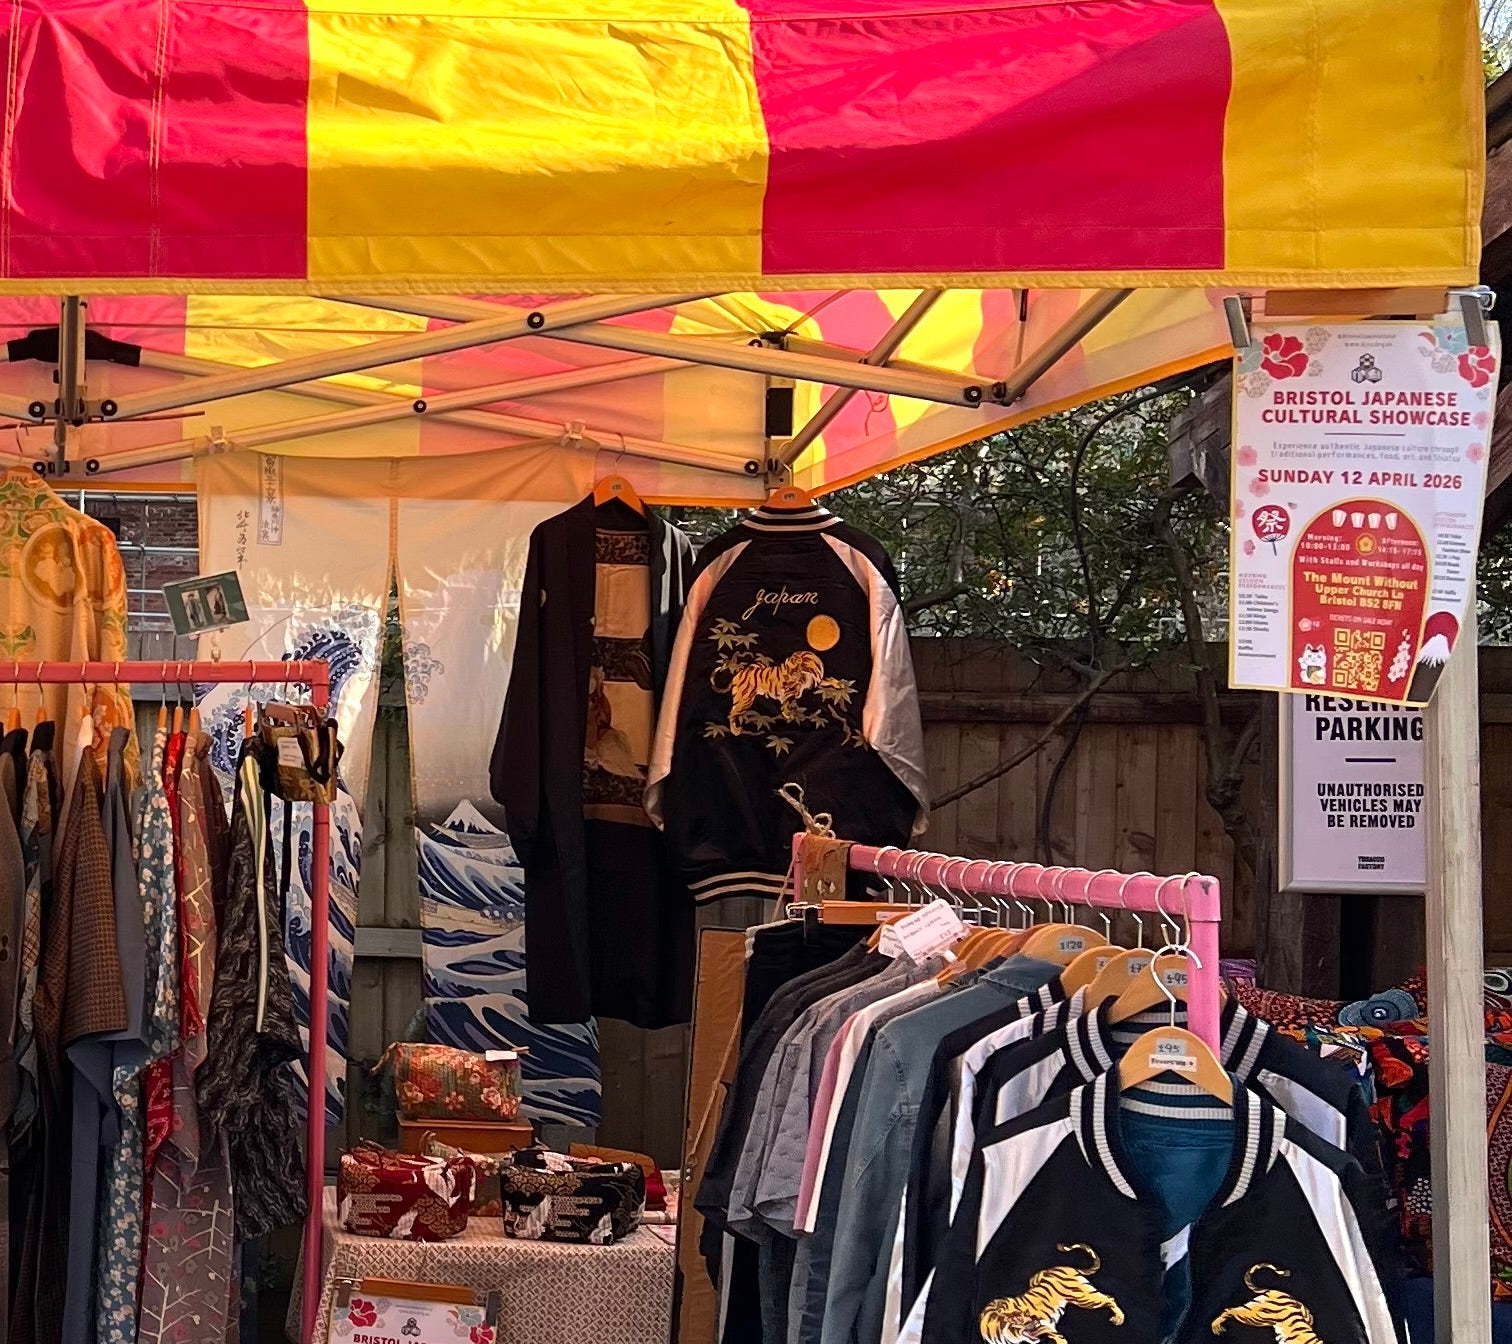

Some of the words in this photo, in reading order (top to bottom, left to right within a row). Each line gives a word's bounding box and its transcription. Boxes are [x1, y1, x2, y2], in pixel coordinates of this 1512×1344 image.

[1273, 391, 1355, 405] BRISTOL
[1361, 391, 1458, 407] JAPANESE
[1262, 409, 1363, 424] CULTURAL
[1369, 410, 1471, 426] SHOWCASE
[1258, 469, 1334, 484] SUNDAY
[1341, 471, 1363, 485] 12
[1368, 472, 1418, 487] APRIL
[1423, 474, 1462, 489] 2026
[1257, 510, 1286, 533] 祭
[1298, 556, 1318, 564] With
[1320, 556, 1344, 565] Stalls
[1361, 559, 1400, 569] Workshops
[1401, 562, 1410, 570] all
[1411, 563, 1424, 572] day
[1303, 571, 1327, 583] The
[1331, 572, 1371, 586] Mount
[1373, 575, 1418, 590] Without
[1315, 584, 1349, 596] Upper
[1352, 586, 1389, 598] Church
[1391, 589, 1404, 600] Ln
[1319, 595, 1357, 607] Bristol
[1360, 597, 1380, 609] BS2
[1316, 716, 1424, 741] PARKING
[1317, 783, 1424, 797] UNAUTHORISED
[1320, 799, 1388, 813] VEHICLES
[1393, 799, 1421, 813] MAY
[1327, 814, 1345, 828] BE
[1349, 814, 1415, 829] REMOVED
[1167, 972, 1188, 985] £95
[1158, 1043, 1180, 1053] £95
